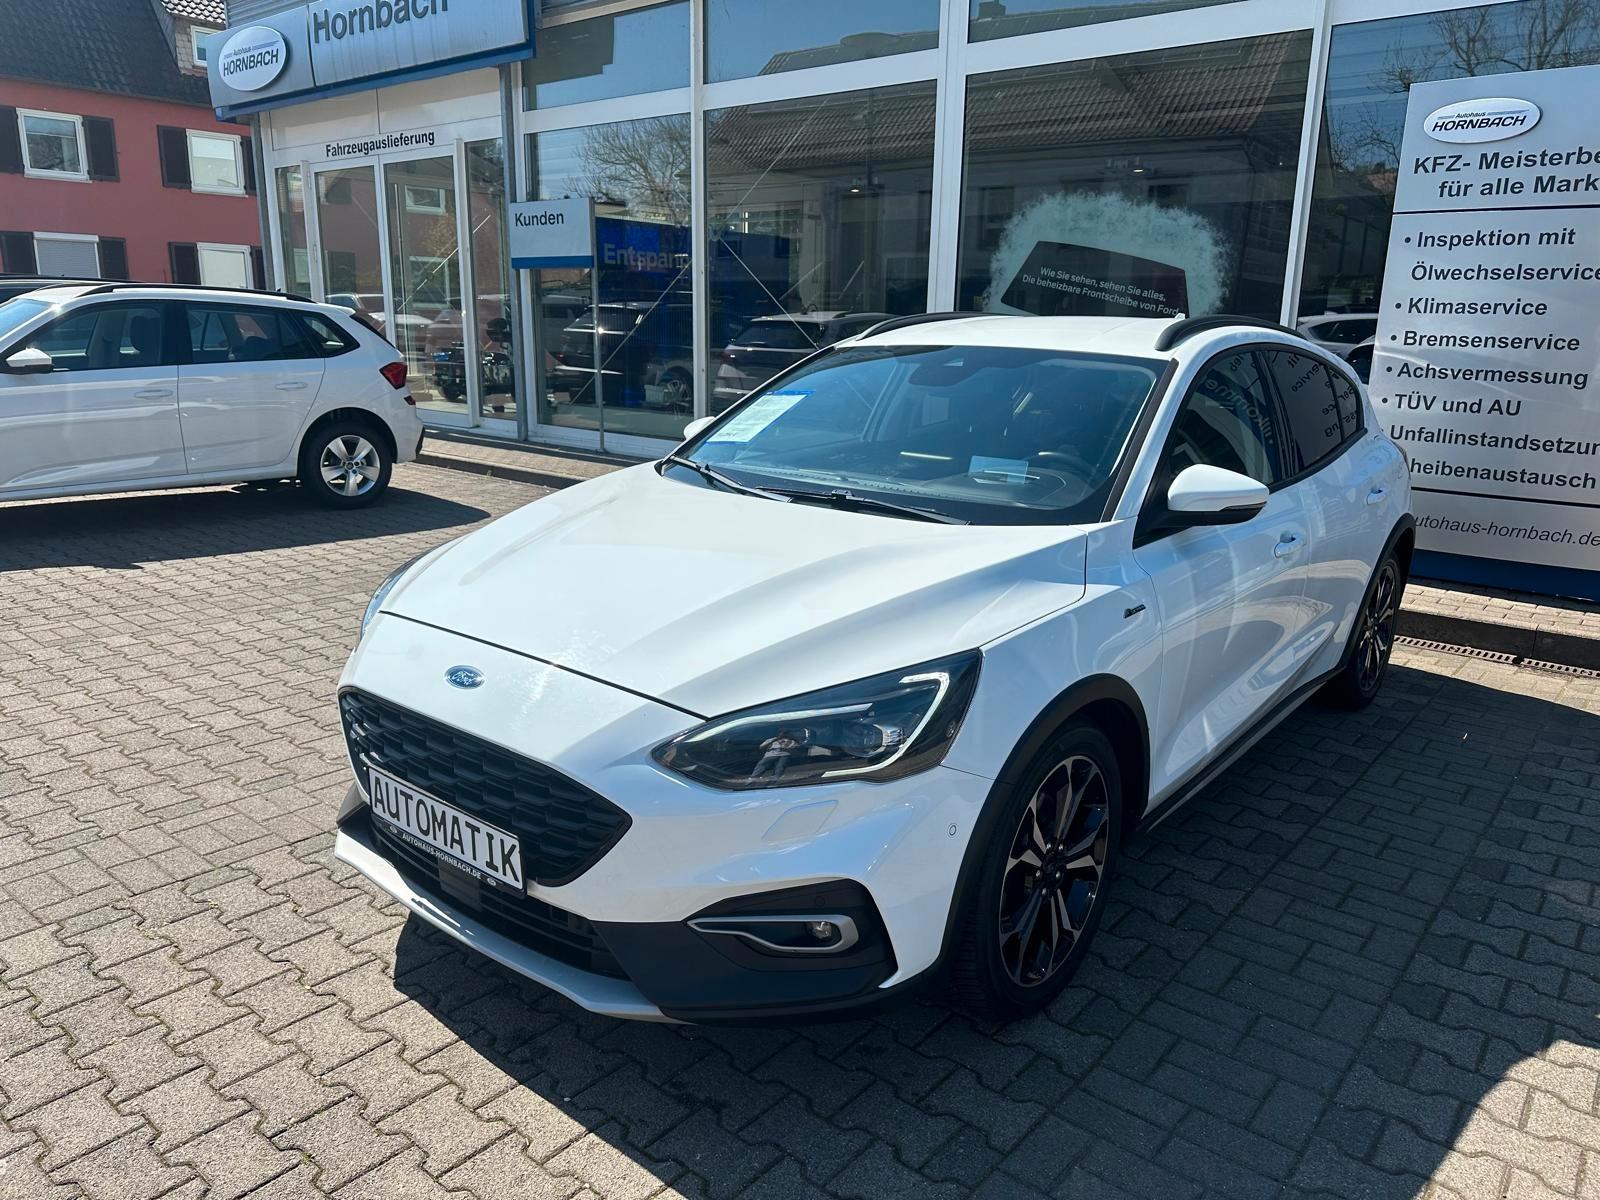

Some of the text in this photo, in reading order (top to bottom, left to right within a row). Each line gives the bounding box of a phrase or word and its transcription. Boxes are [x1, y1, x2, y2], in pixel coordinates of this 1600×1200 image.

[223, 48, 279, 77] HORNBACH
[1432, 115, 1527, 132] HORNBACH
[325, 130, 435, 157] Fahrzeugauslieferung
[1413, 155, 1471, 174] KFZ-
[1438, 180, 1474, 198] für
[1480, 178, 1524, 195] alle
[515, 211, 564, 227] Kunden
[1417, 228, 1576, 250] Inspektion mit
[1022, 274, 1036, 284] Die
[1036, 277, 1081, 294] beheizbare
[1082, 287, 1138, 307] Frontscheibe
[1140, 302, 1156, 311] von
[1040, 266, 1056, 277] Wie
[1057, 270, 1071, 280] Sie
[1071, 274, 1098, 287] sehen,
[1099, 281, 1126, 292] sehen
[1127, 285, 1141, 296] Sie
[1407, 297, 1548, 315] Klimaservice
[1403, 330, 1580, 351] Bremsenservice
[1397, 362, 1589, 390] Achsvermessung
[1395, 391, 1522, 416] TÜV und AU
[373, 776, 519, 882] AUTOMATIK
[402, 833, 481, 880] AUTOHAUS-HORNBACH.DE
